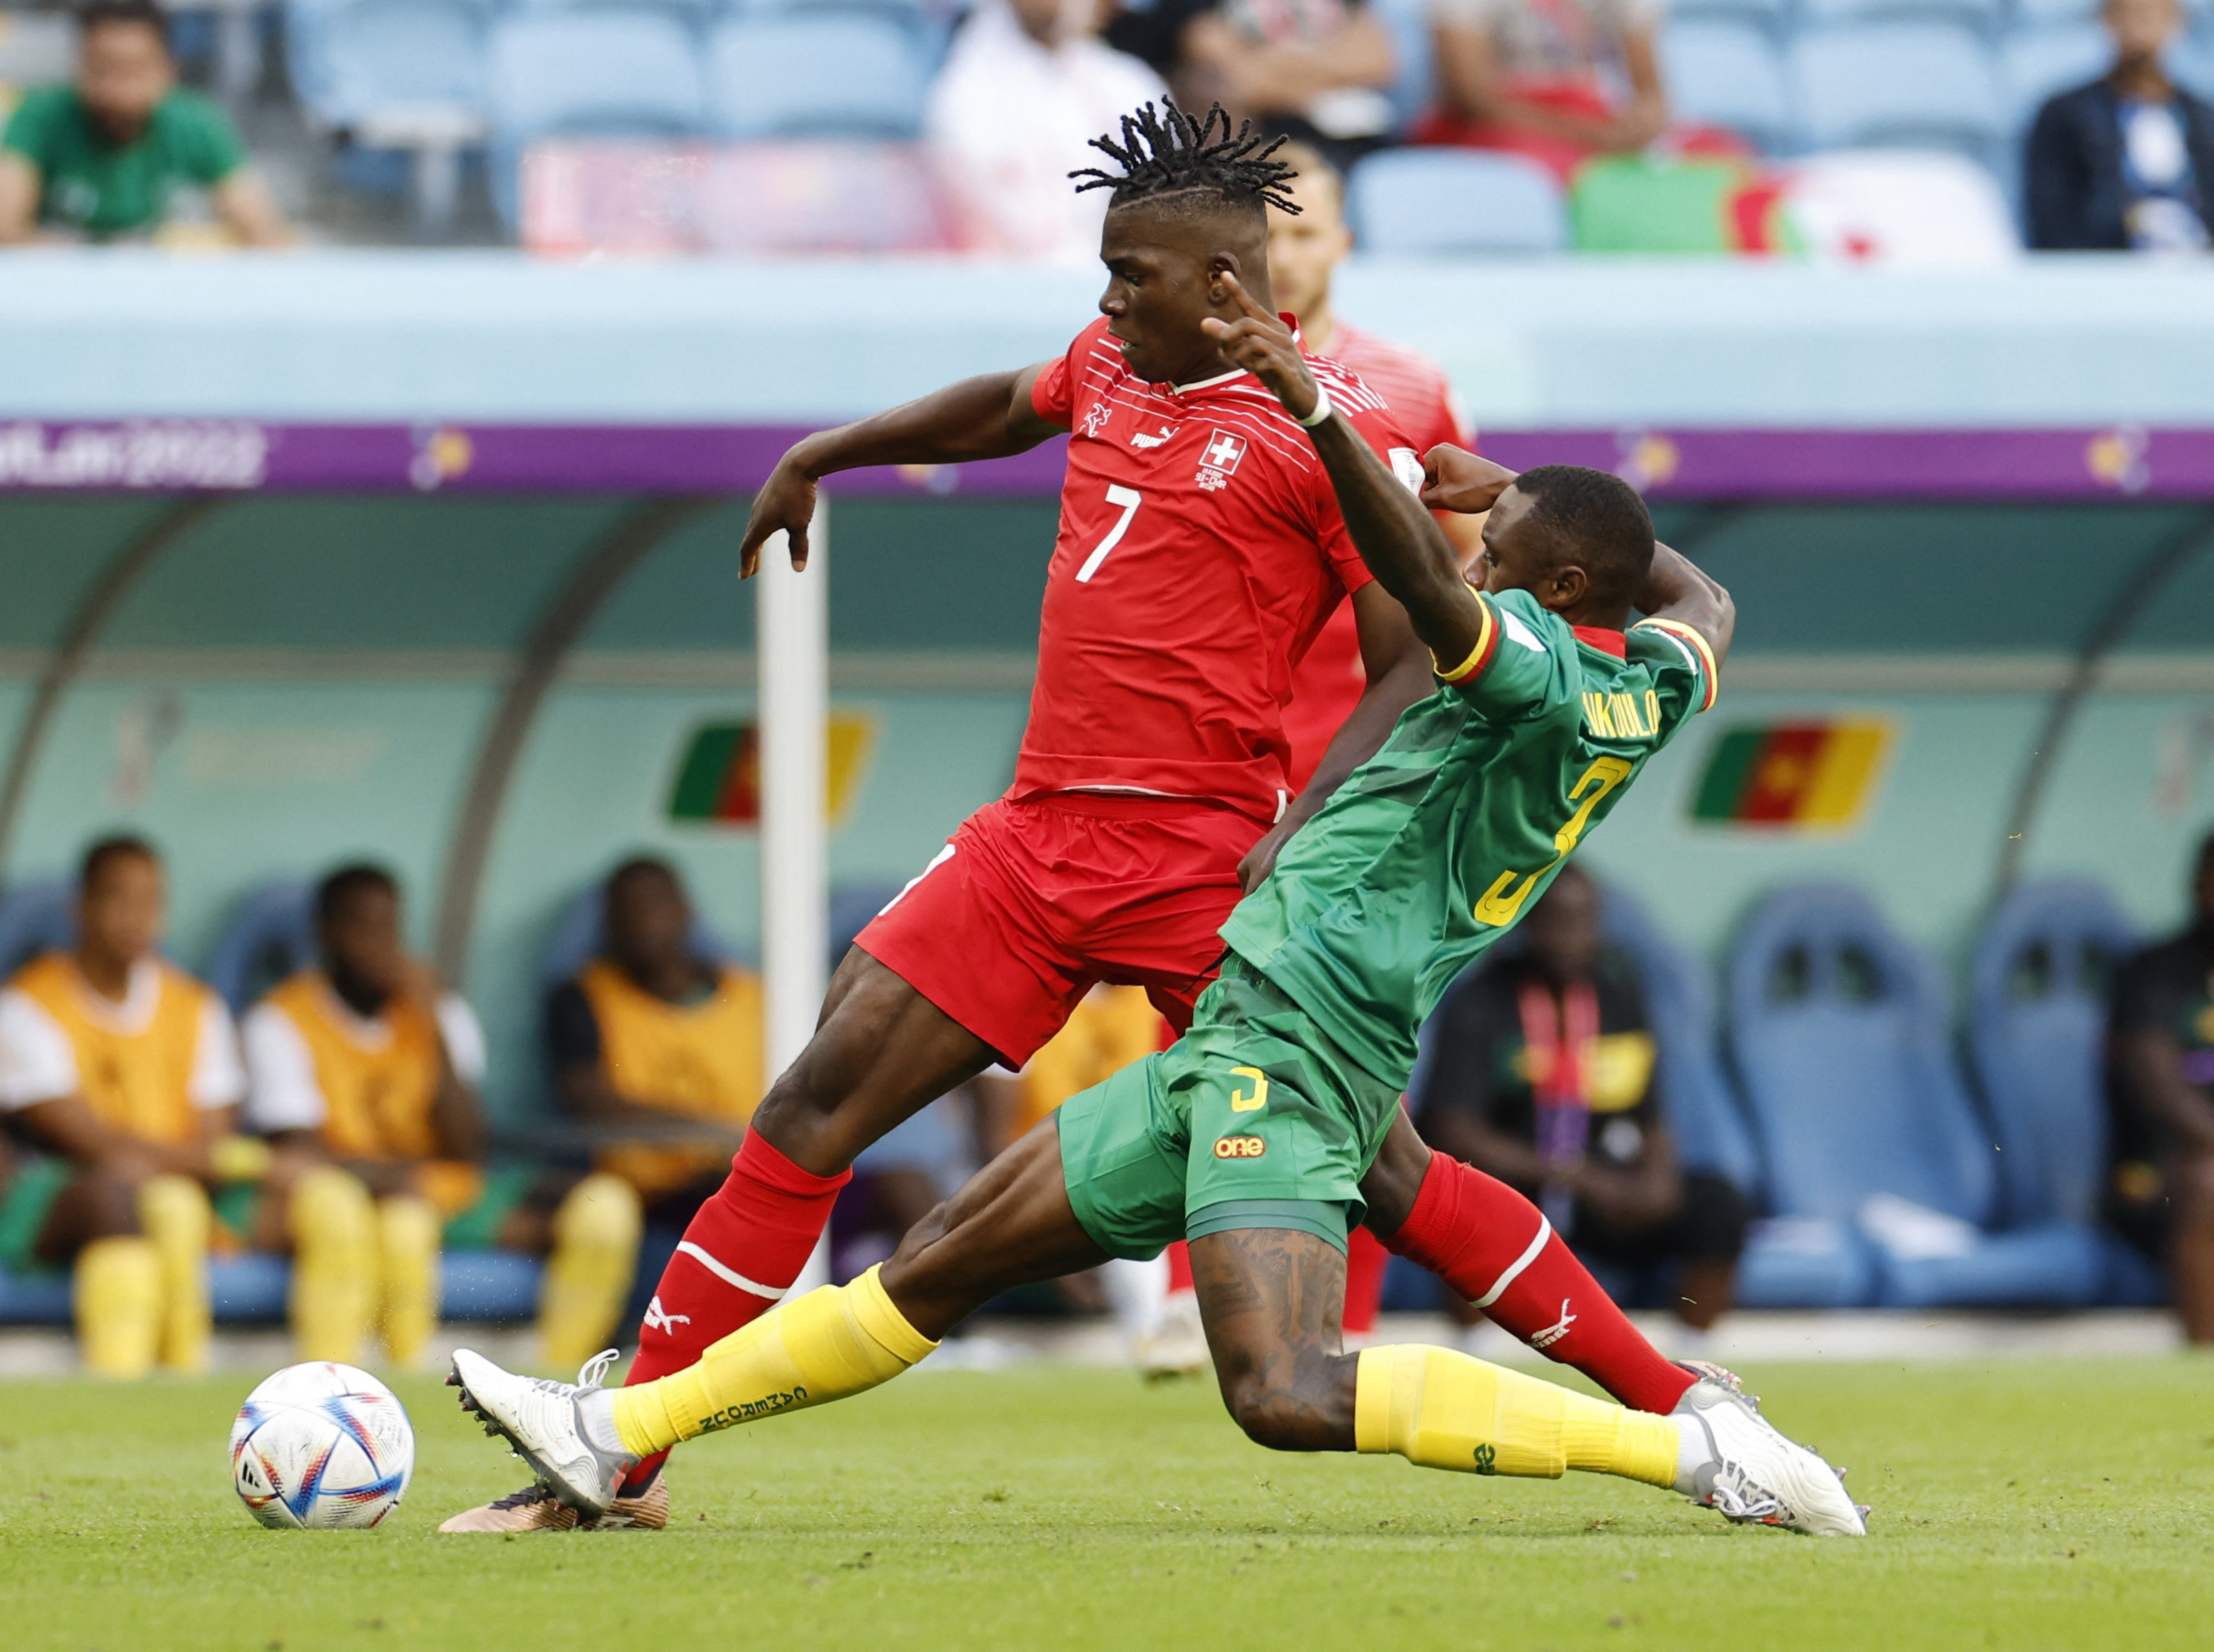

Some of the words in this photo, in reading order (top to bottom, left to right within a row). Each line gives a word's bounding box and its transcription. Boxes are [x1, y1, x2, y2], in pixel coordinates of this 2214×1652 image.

[1074, 484, 1142, 583] 7
[1582, 689, 1662, 738] NKOULO
[1474, 756, 1632, 927] 3
[1215, 1137, 1264, 1158] one
[699, 1386, 808, 1431] CAMEROUN
